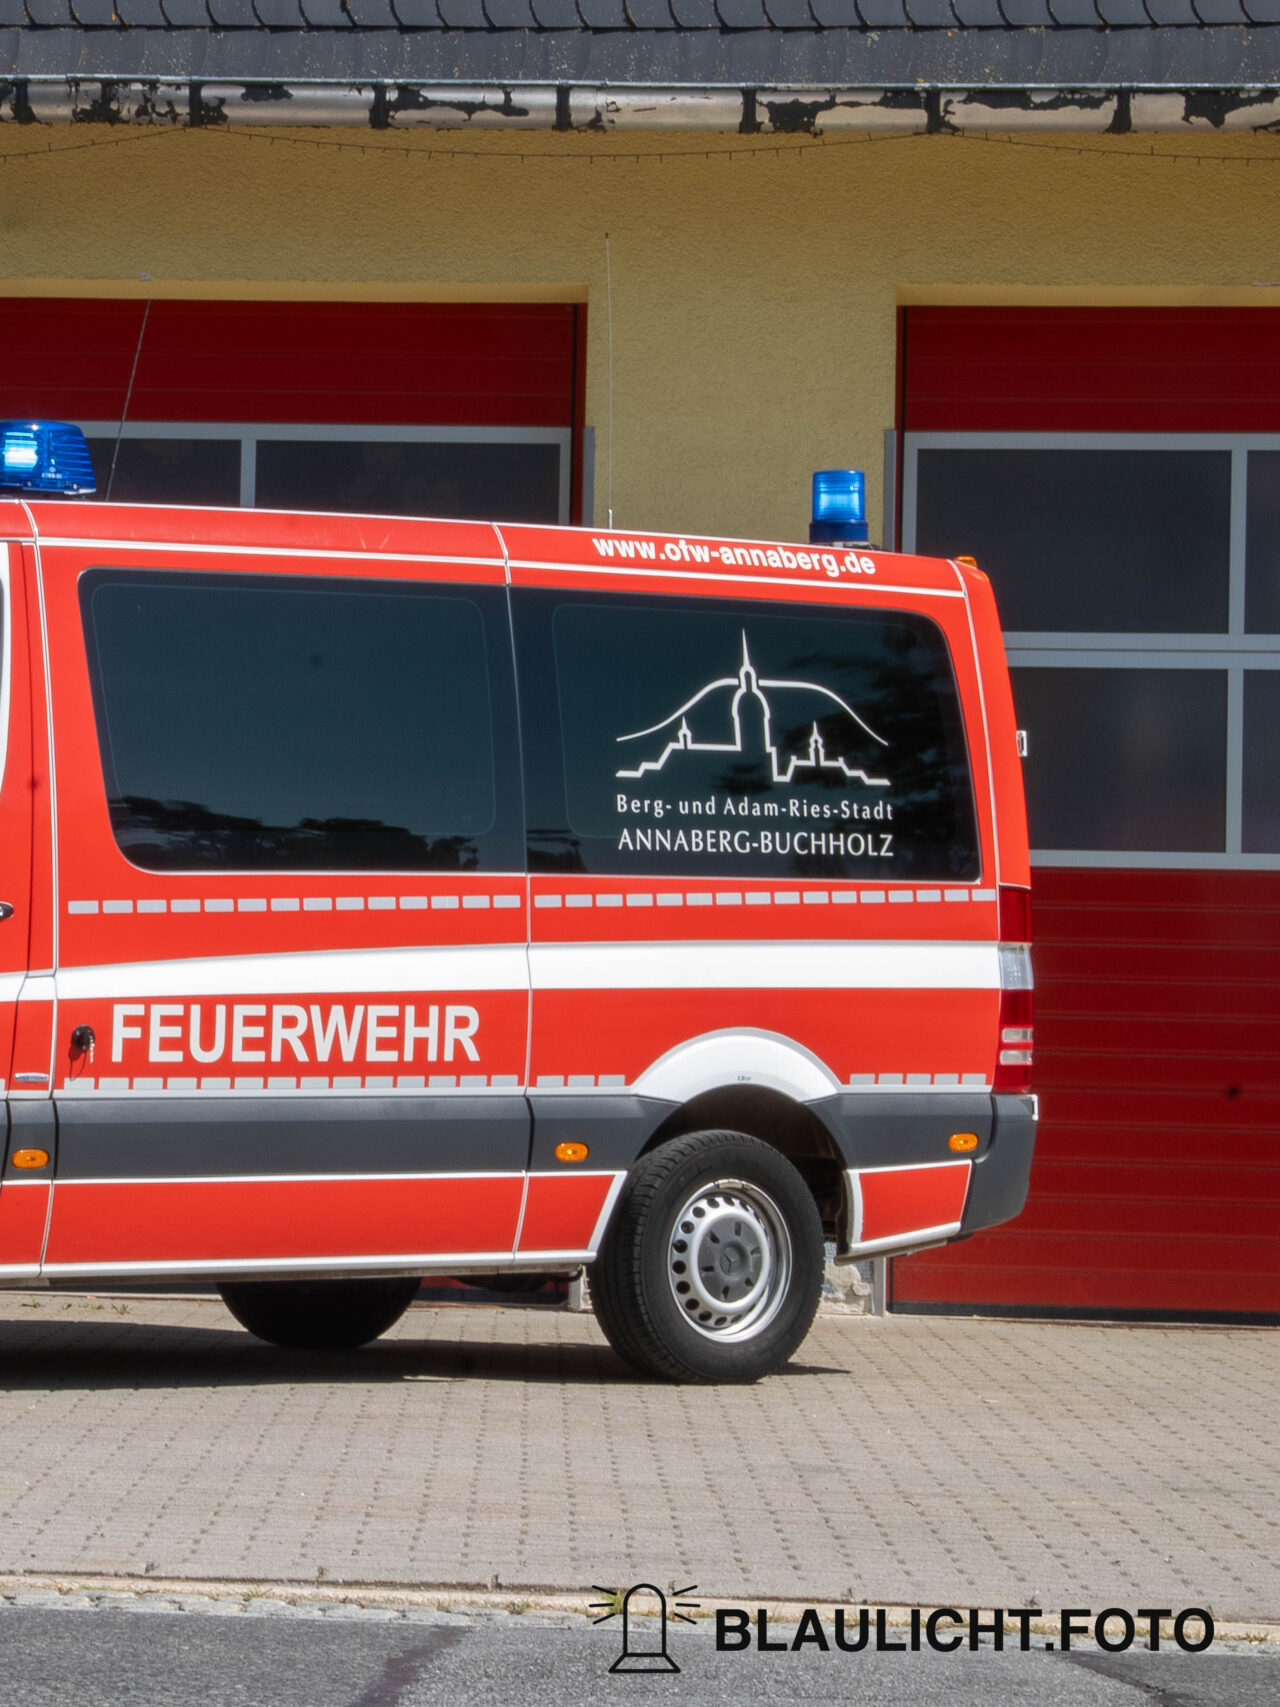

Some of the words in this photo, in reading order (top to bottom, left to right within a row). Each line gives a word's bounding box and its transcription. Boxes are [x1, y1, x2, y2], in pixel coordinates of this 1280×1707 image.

[592, 537, 876, 577] www.ofw-annaberg.de
[617, 794, 672, 818] Berg-
[679, 796, 716, 815] und
[723, 796, 894, 820] Adam-Ries-Stadt
[618, 828, 894, 857] ANNABERG-BUCHHOLZ
[111, 1004, 481, 1063] FEUERWEHR
